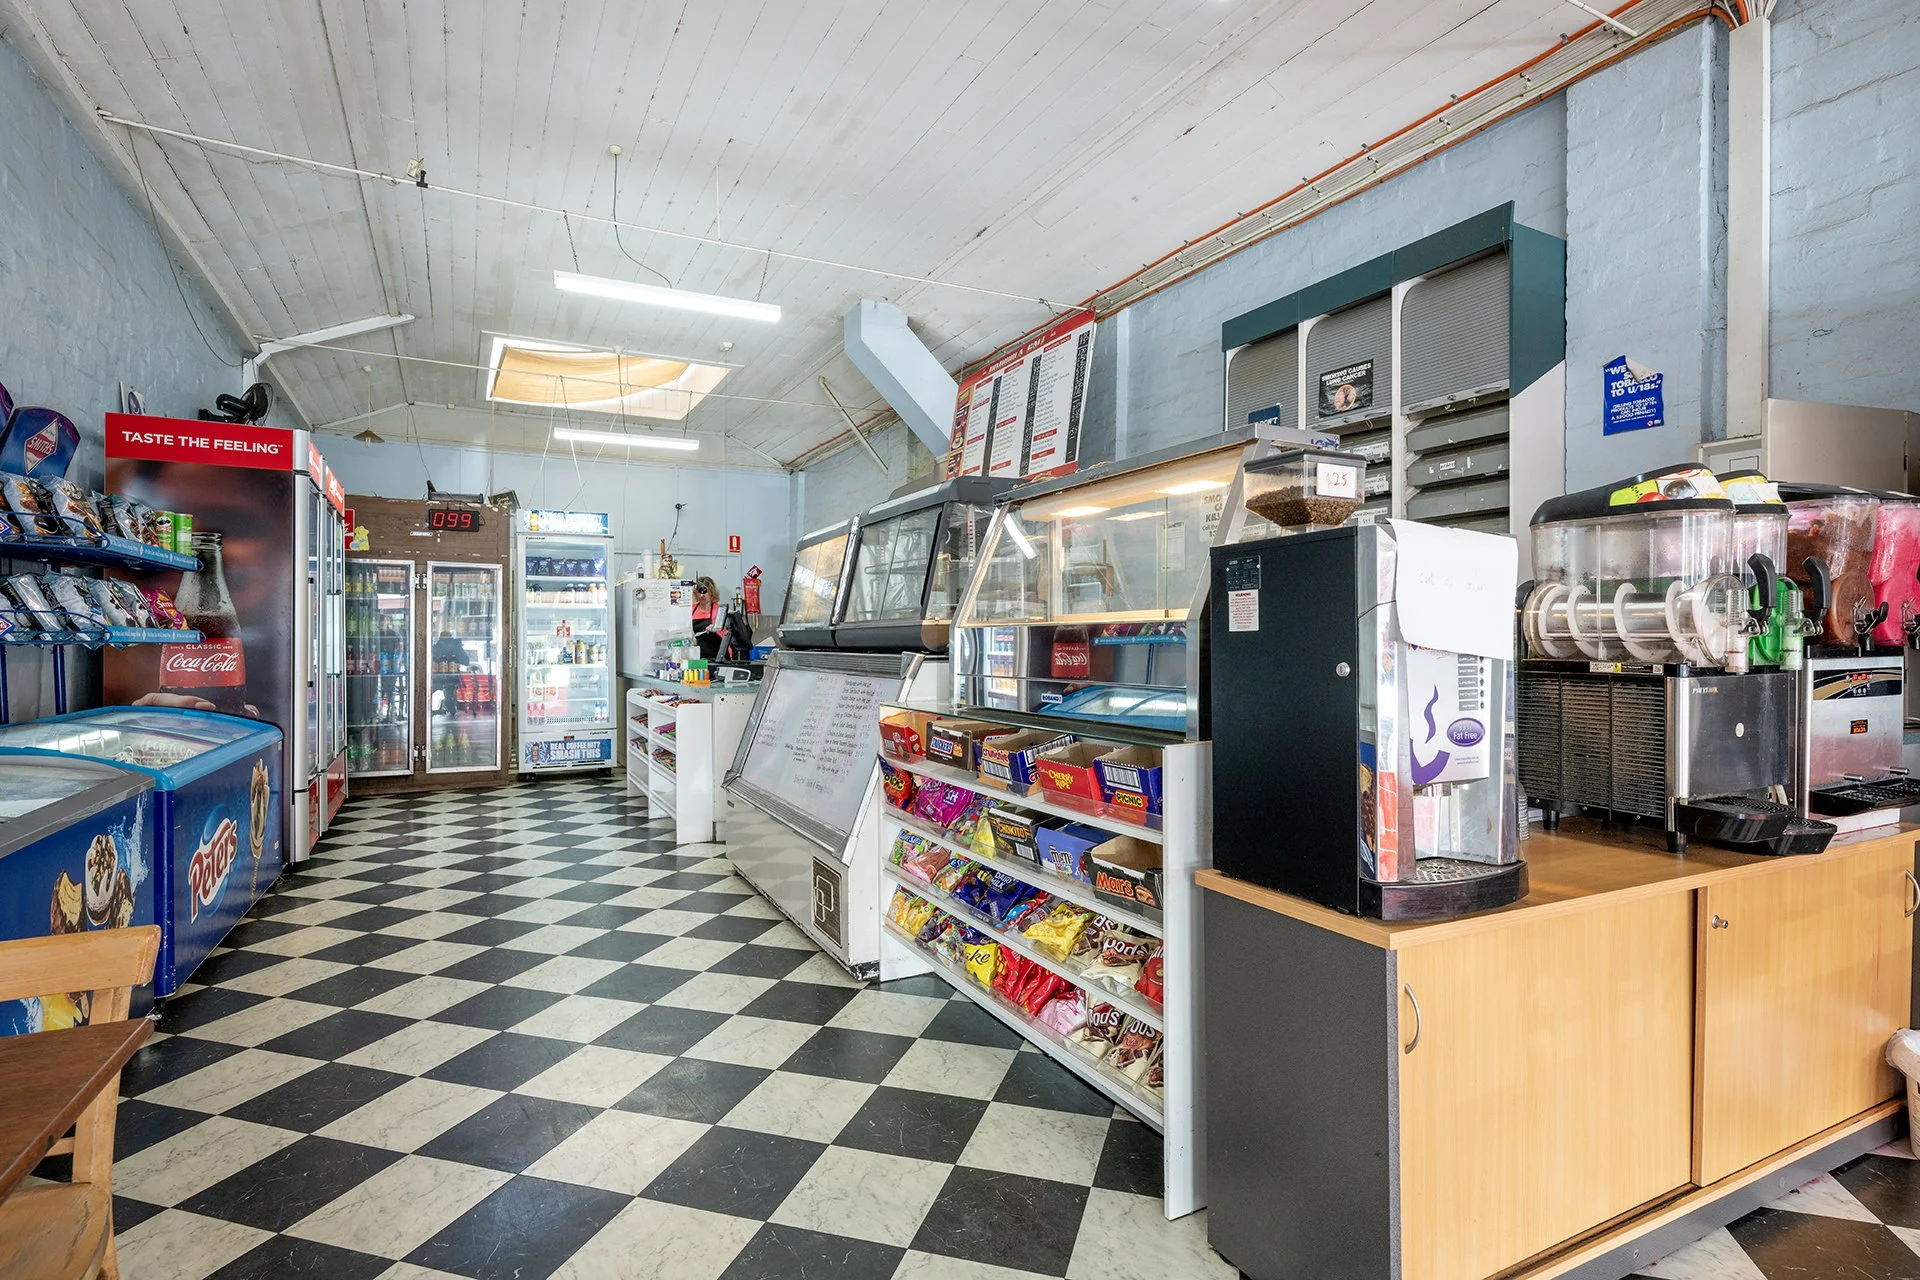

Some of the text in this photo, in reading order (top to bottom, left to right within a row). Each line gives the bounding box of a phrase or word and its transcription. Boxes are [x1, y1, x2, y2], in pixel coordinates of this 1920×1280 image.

[1321, 362, 1372, 382] SMOKING CAUSES
[1326, 370, 1366, 386] LUNG CANCER
[1611, 388, 1625, 397] TO
[122, 431, 279, 455] TASTE THE FEELING
[432, 512, 472, 529] 099
[166, 652, 240, 673] Coca-Cola
[1453, 730, 1478, 740] Fat Free
[931, 737, 953, 753] SNICKERS
[550, 748, 601, 760] SMASH THIS
[1048, 769, 1074, 785] CHERRY
[1116, 792, 1143, 807] PICNIC
[998, 822, 1026, 839] CHOKITO
[1096, 872, 1134, 897] Mars
